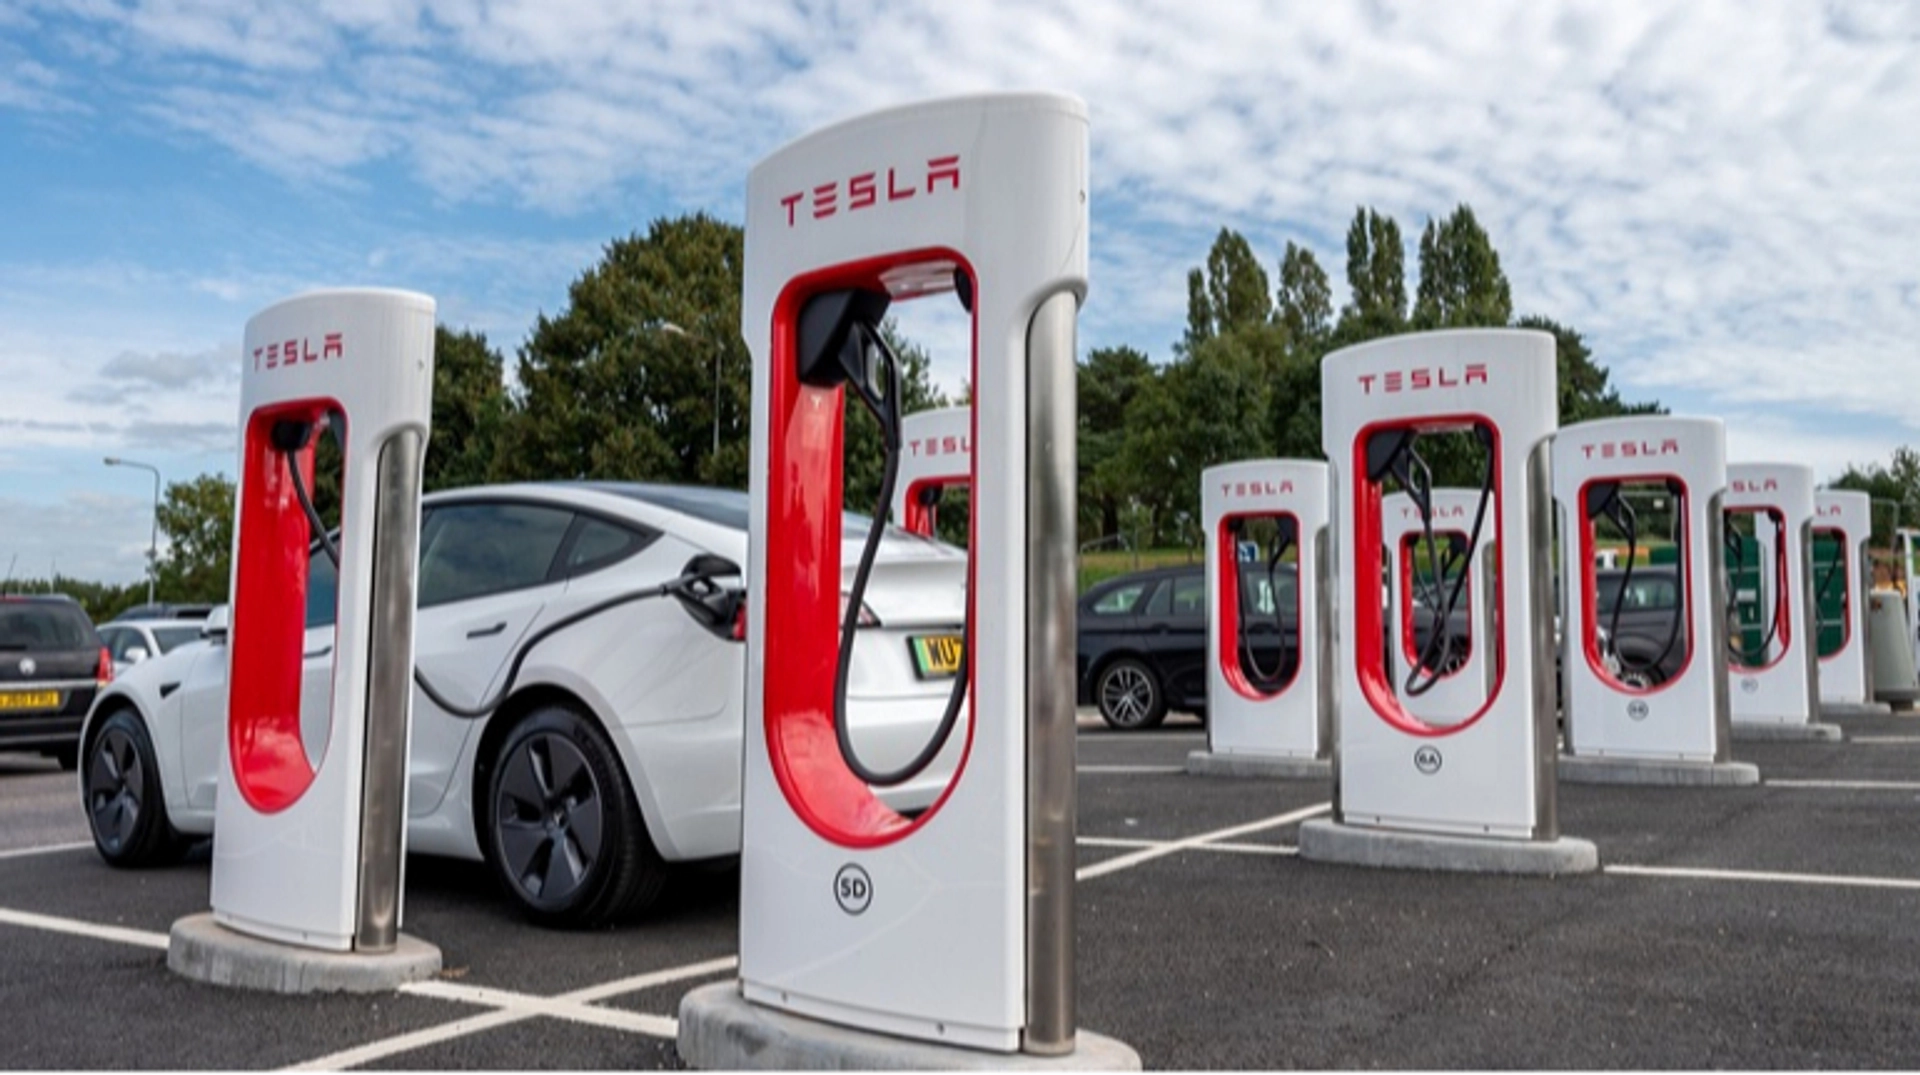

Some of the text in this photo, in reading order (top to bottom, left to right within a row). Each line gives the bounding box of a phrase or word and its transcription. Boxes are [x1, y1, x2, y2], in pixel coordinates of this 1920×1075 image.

[780, 154, 961, 228] TESLA
[253, 332, 343, 373] TESLA
[1357, 362, 1488, 395] TESLA
[908, 436, 970, 457] TESL
[1581, 439, 1678, 460] TESLA
[1221, 480, 1293, 498] TESLA
[1732, 478, 1777, 492] SLA
